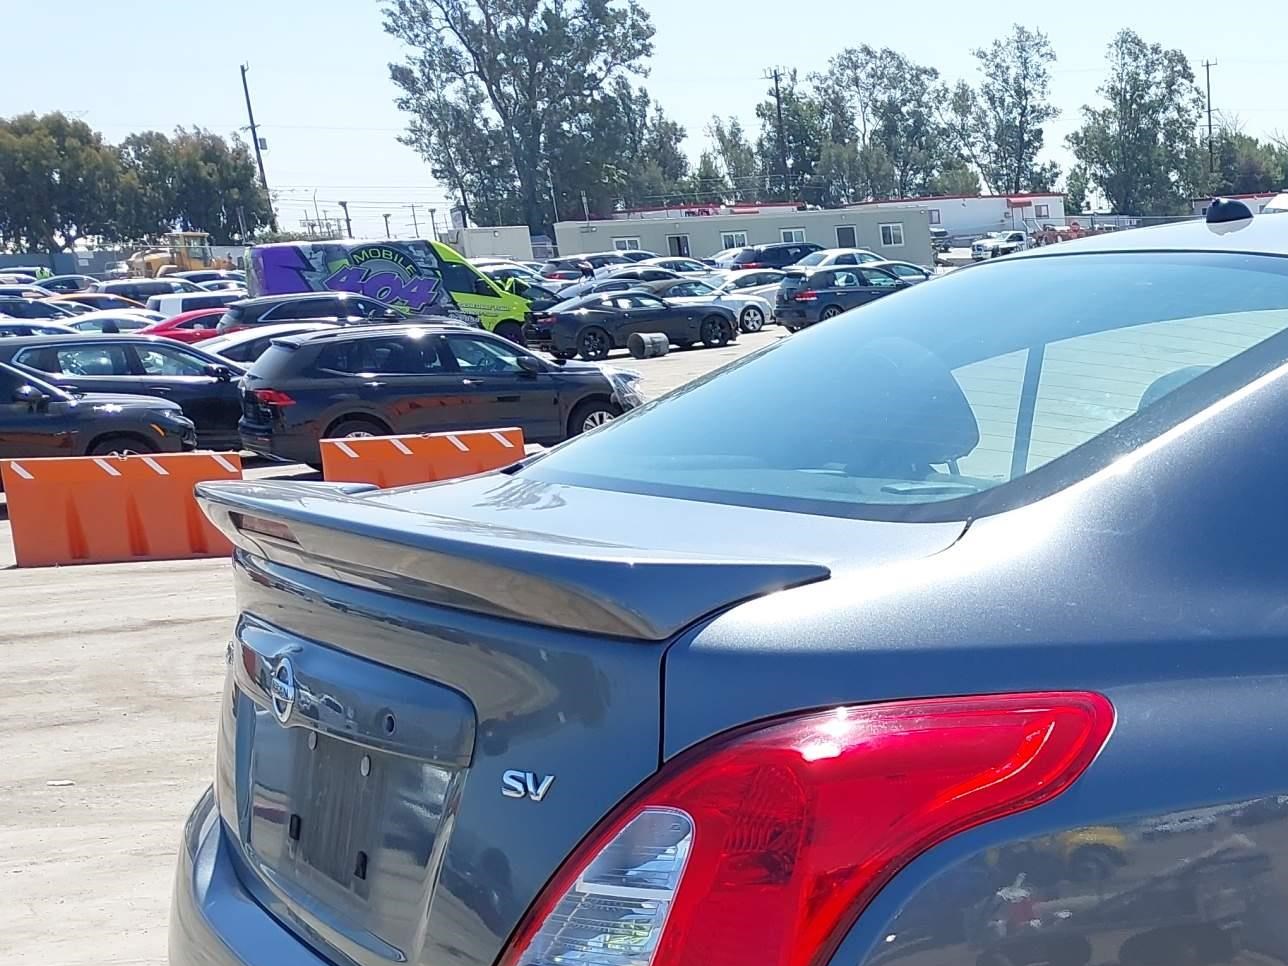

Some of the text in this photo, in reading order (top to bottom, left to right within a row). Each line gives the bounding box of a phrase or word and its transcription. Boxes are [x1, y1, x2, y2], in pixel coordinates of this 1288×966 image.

[353, 248, 417, 277] MOBILE
[323, 265, 442, 312] 404
[501, 769, 555, 801] SV
